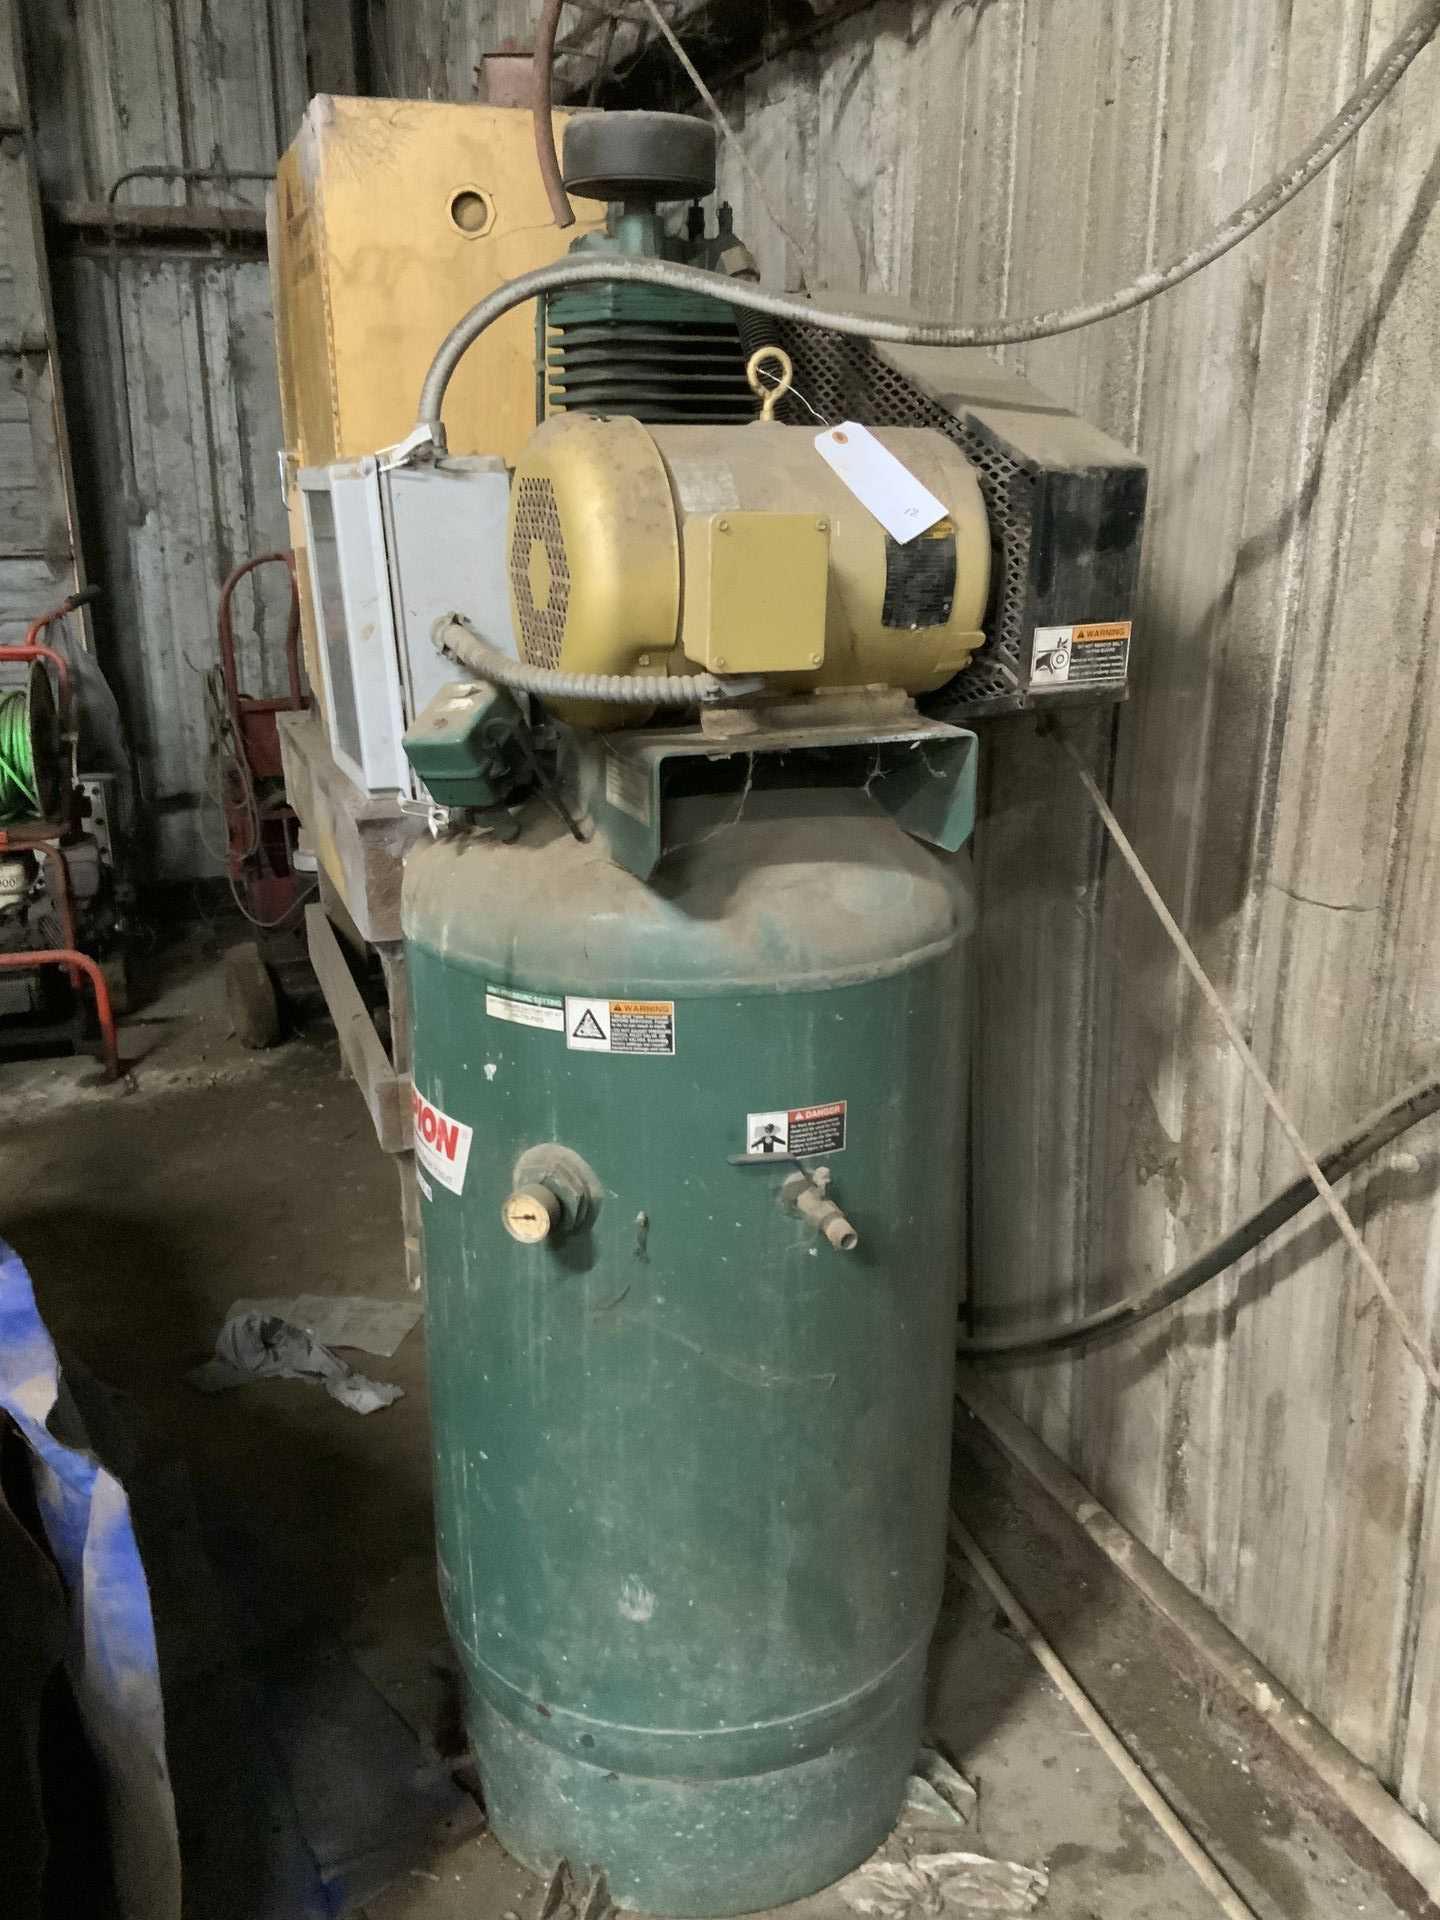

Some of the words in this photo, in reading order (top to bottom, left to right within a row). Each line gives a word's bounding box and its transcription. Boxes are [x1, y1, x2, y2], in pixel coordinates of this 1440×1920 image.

[1086, 628, 1125, 638] WARNING
[0, 879, 16, 888] 00
[623, 1003, 669, 1012] WARNING
[805, 1104, 840, 1120] DANGER
